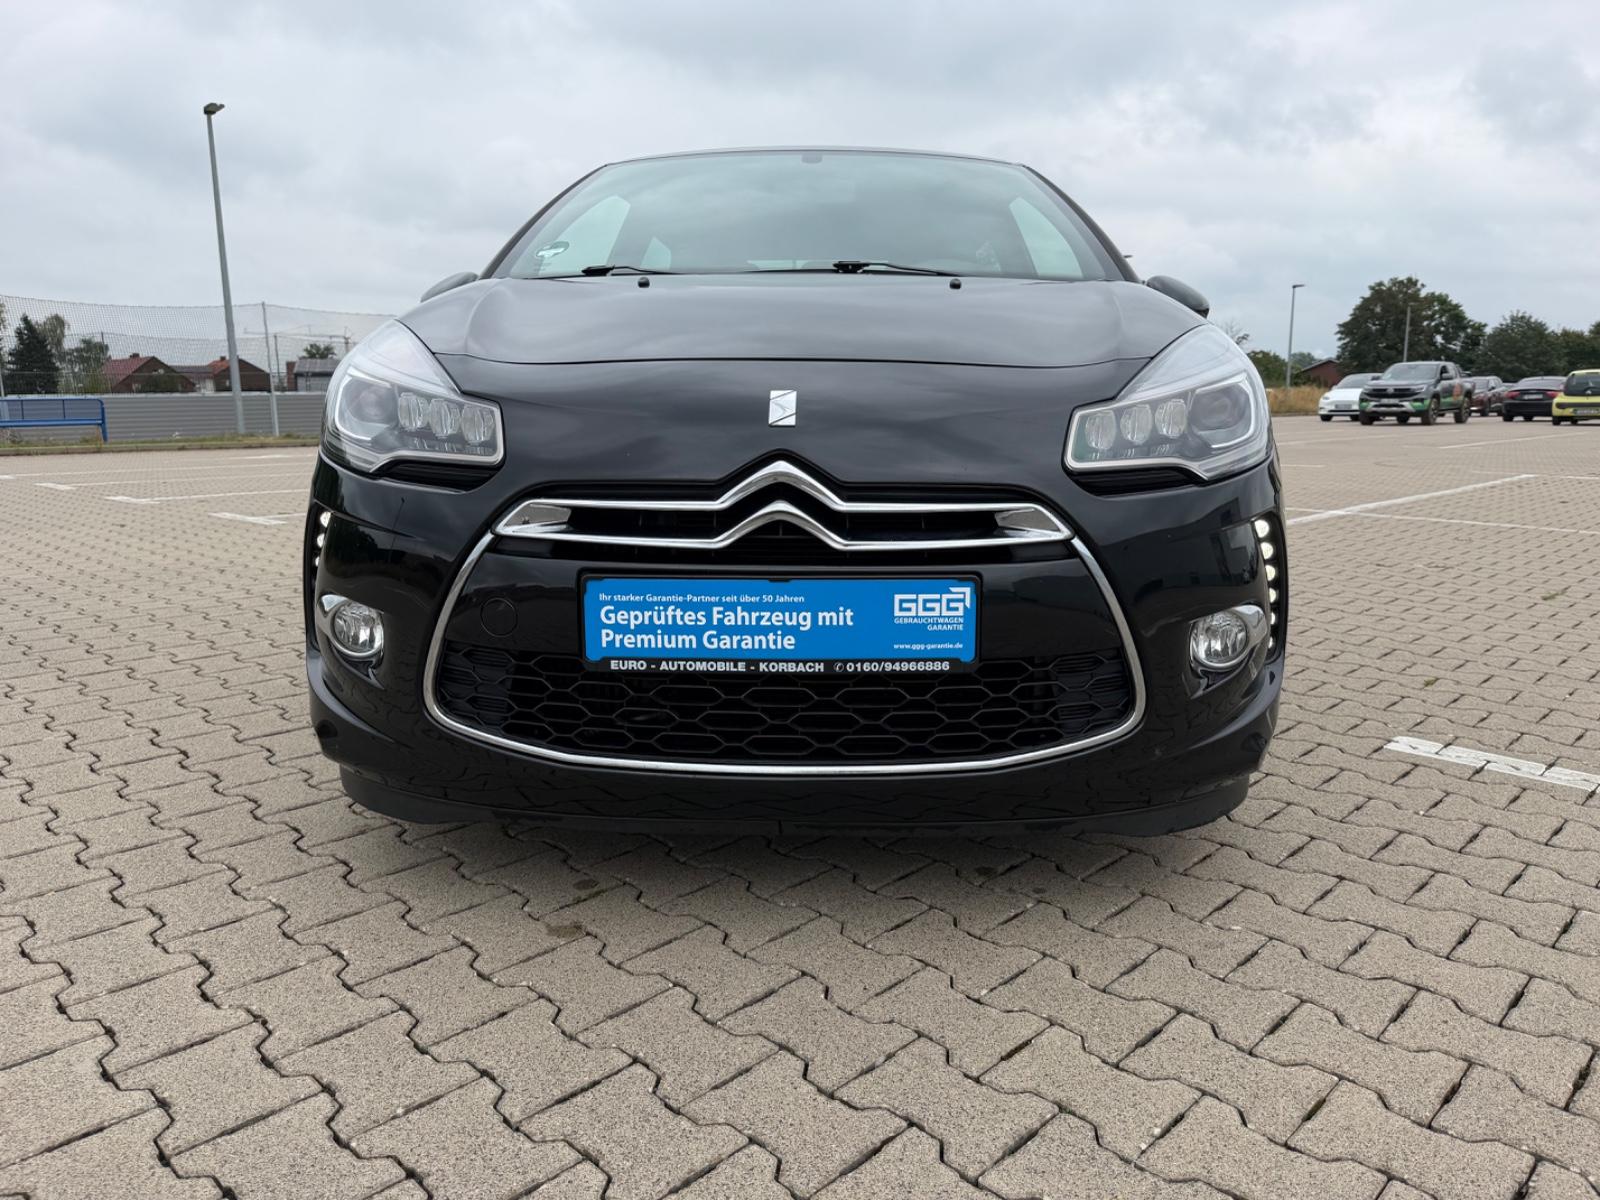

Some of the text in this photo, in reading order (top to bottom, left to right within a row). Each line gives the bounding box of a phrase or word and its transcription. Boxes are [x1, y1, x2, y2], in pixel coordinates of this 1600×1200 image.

[599, 593, 805, 603] Ihr starker Garantie-Partner seit über 50 Jahren
[894, 594, 965, 617] GGG
[600, 605, 854, 631] Geprüftes Fahrzeug mit
[894, 616, 964, 624] GEBRAUCHTWAGEN
[601, 629, 796, 650] Premium Garantie
[894, 642, 964, 650] www.ggg-garantie.de
[610, 660, 647, 671] EURO
[659, 661, 746, 672] AUTOMOBILE
[759, 662, 824, 673] KORBACH
[846, 661, 950, 673] 0160/94966886
